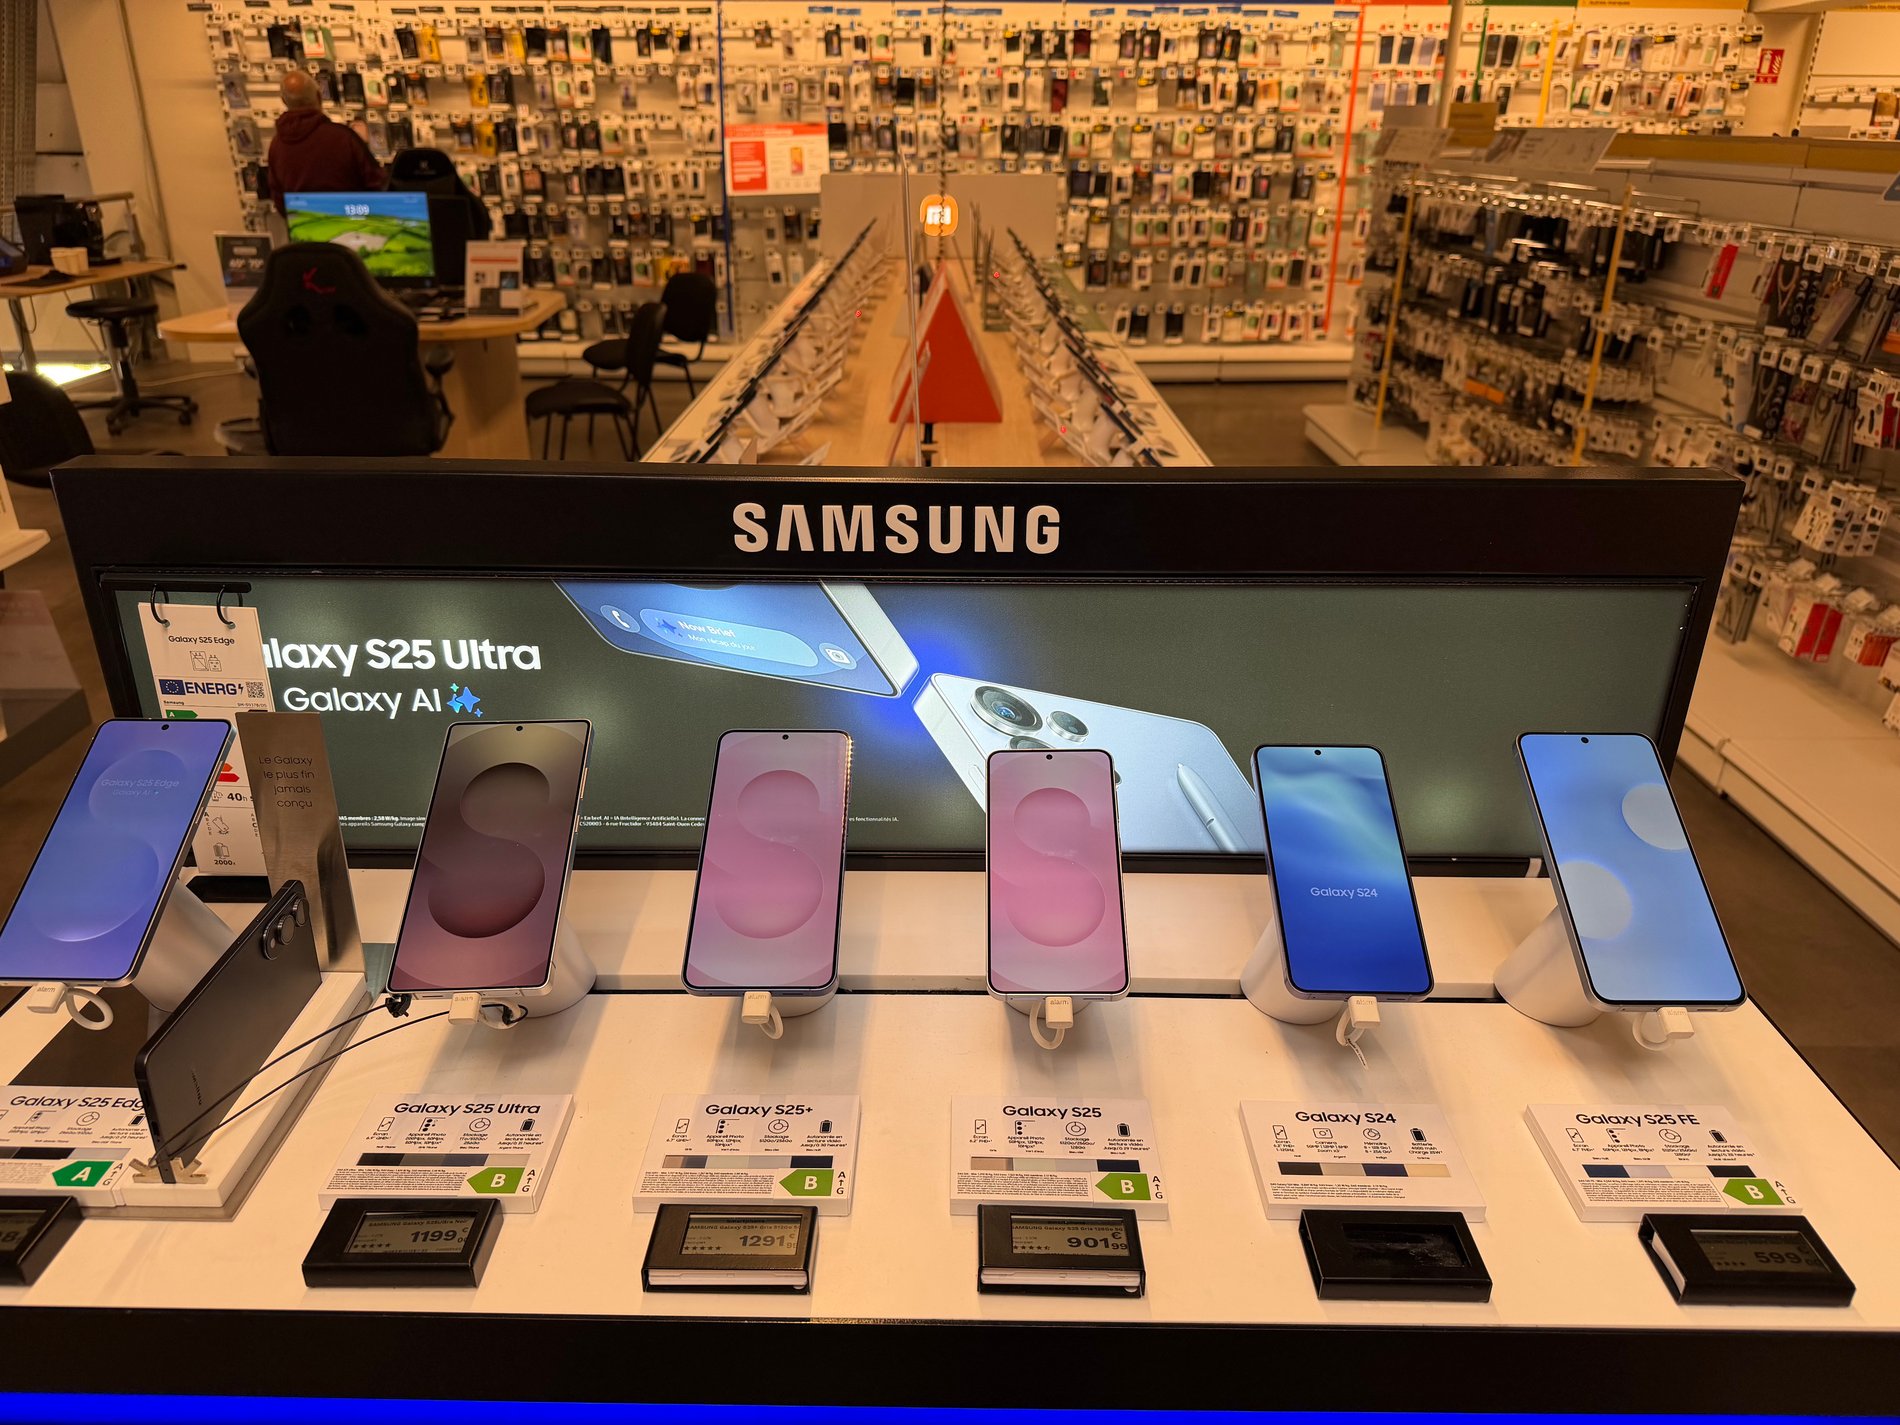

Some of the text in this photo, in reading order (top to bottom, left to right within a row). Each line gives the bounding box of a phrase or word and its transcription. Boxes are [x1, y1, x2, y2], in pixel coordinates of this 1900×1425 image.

[733, 502, 1060, 554] SAMSUNG
[678, 620, 736, 639] Now Brief
[168, 635, 235, 646] Galaxy S25 Edge
[687, 633, 706, 643] Mon
[262, 638, 542, 677] laxy S25 Ultra
[185, 682, 237, 695] ENERG
[283, 687, 442, 719] Galaxy AI
[259, 756, 312, 768] Le Galaxy
[264, 770, 315, 780] le plus fin
[101, 779, 134, 787] Galaxy
[154, 779, 179, 788] Edge
[274, 785, 311, 795] jamais
[276, 799, 313, 809] conçu
[1310, 887, 1378, 898] Galaxy S24
[10, 1096, 145, 1111] Galaxy S25 Edg
[394, 1103, 541, 1116] Galaxy S25 Ultra
[705, 1104, 813, 1117] Galaxy S25+
[1002, 1105, 1102, 1120] Galaxy S25
[1295, 1111, 1397, 1125] Galaxy S24
[1575, 1113, 1700, 1127] Galaxy S25 FE
[113, 1162, 123, 1170] A
[526, 1168, 536, 1177] A
[71, 1166, 92, 1181] A
[837, 1171, 846, 1179] A
[1152, 1175, 1161, 1183] A
[102, 1178, 112, 1186] G
[490, 1173, 506, 1188] B
[804, 1175, 818, 1190] B
[1120, 1179, 1135, 1194] B
[1774, 1180, 1783, 1188] A
[521, 1184, 530, 1193] G
[835, 1187, 844, 1195] G
[1745, 1184, 1764, 1200] B
[1154, 1191, 1163, 1200] G
[411, 1229, 457, 1243] 1199
[739, 1235, 785, 1247] 1291
[1066, 1237, 1110, 1249] 901
[1111, 1231, 1122, 1240] €
[1753, 1251, 1802, 1264] 599
